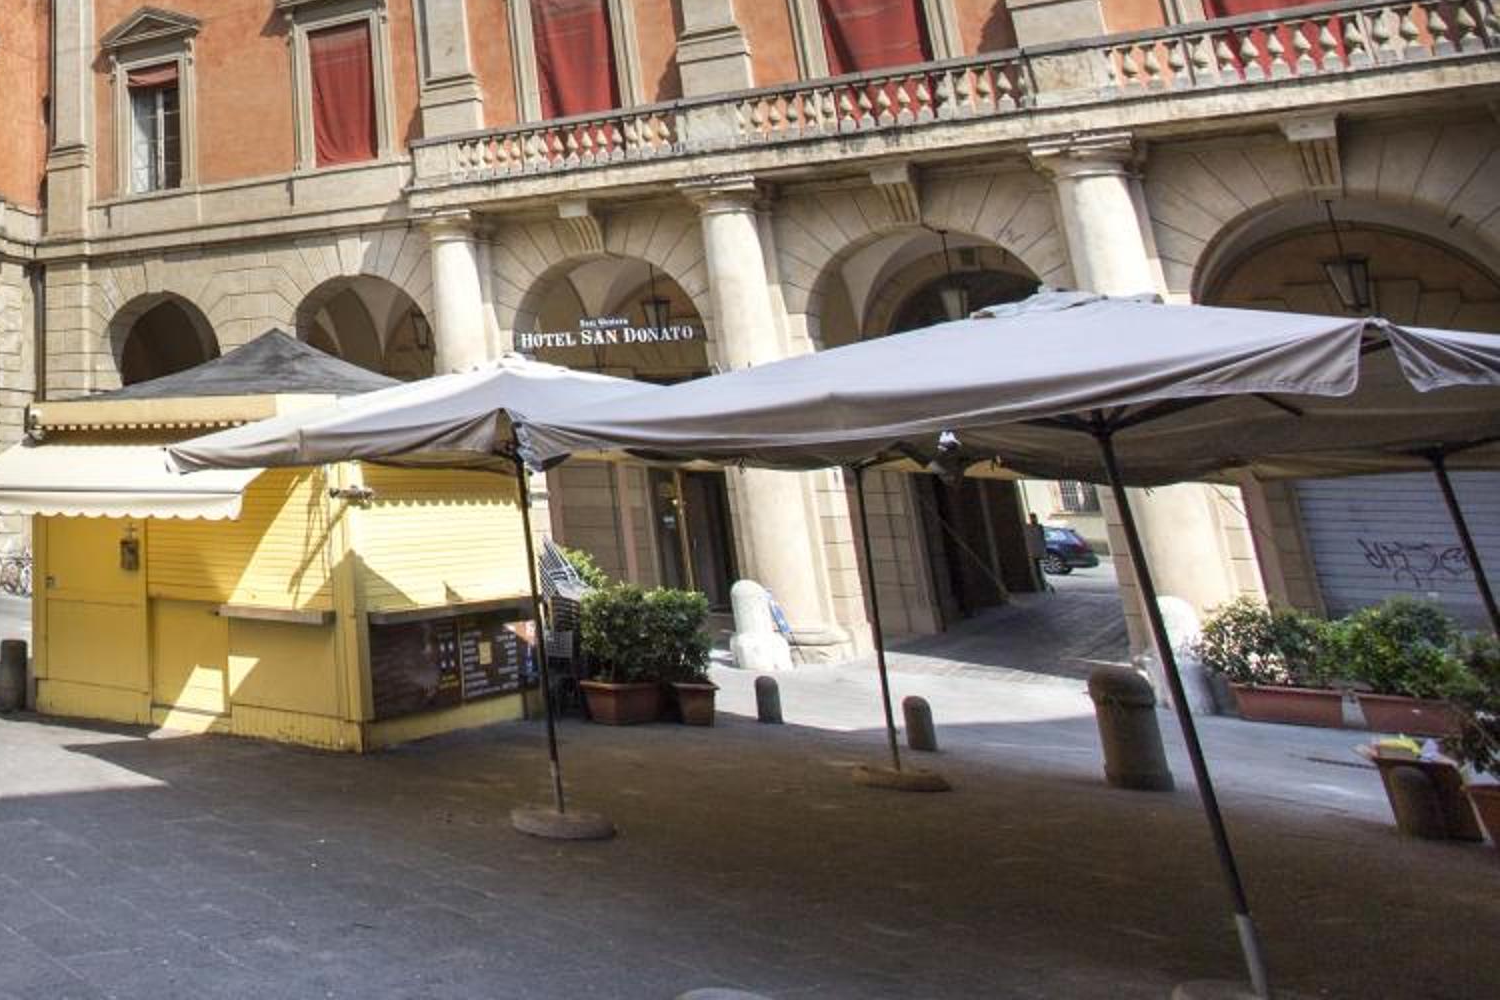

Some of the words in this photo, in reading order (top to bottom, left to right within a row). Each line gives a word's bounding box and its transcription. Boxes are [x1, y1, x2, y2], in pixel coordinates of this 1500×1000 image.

[521, 331, 577, 349] HOTEL
[581, 328, 618, 345] SAN
[623, 325, 694, 344] DONATO
